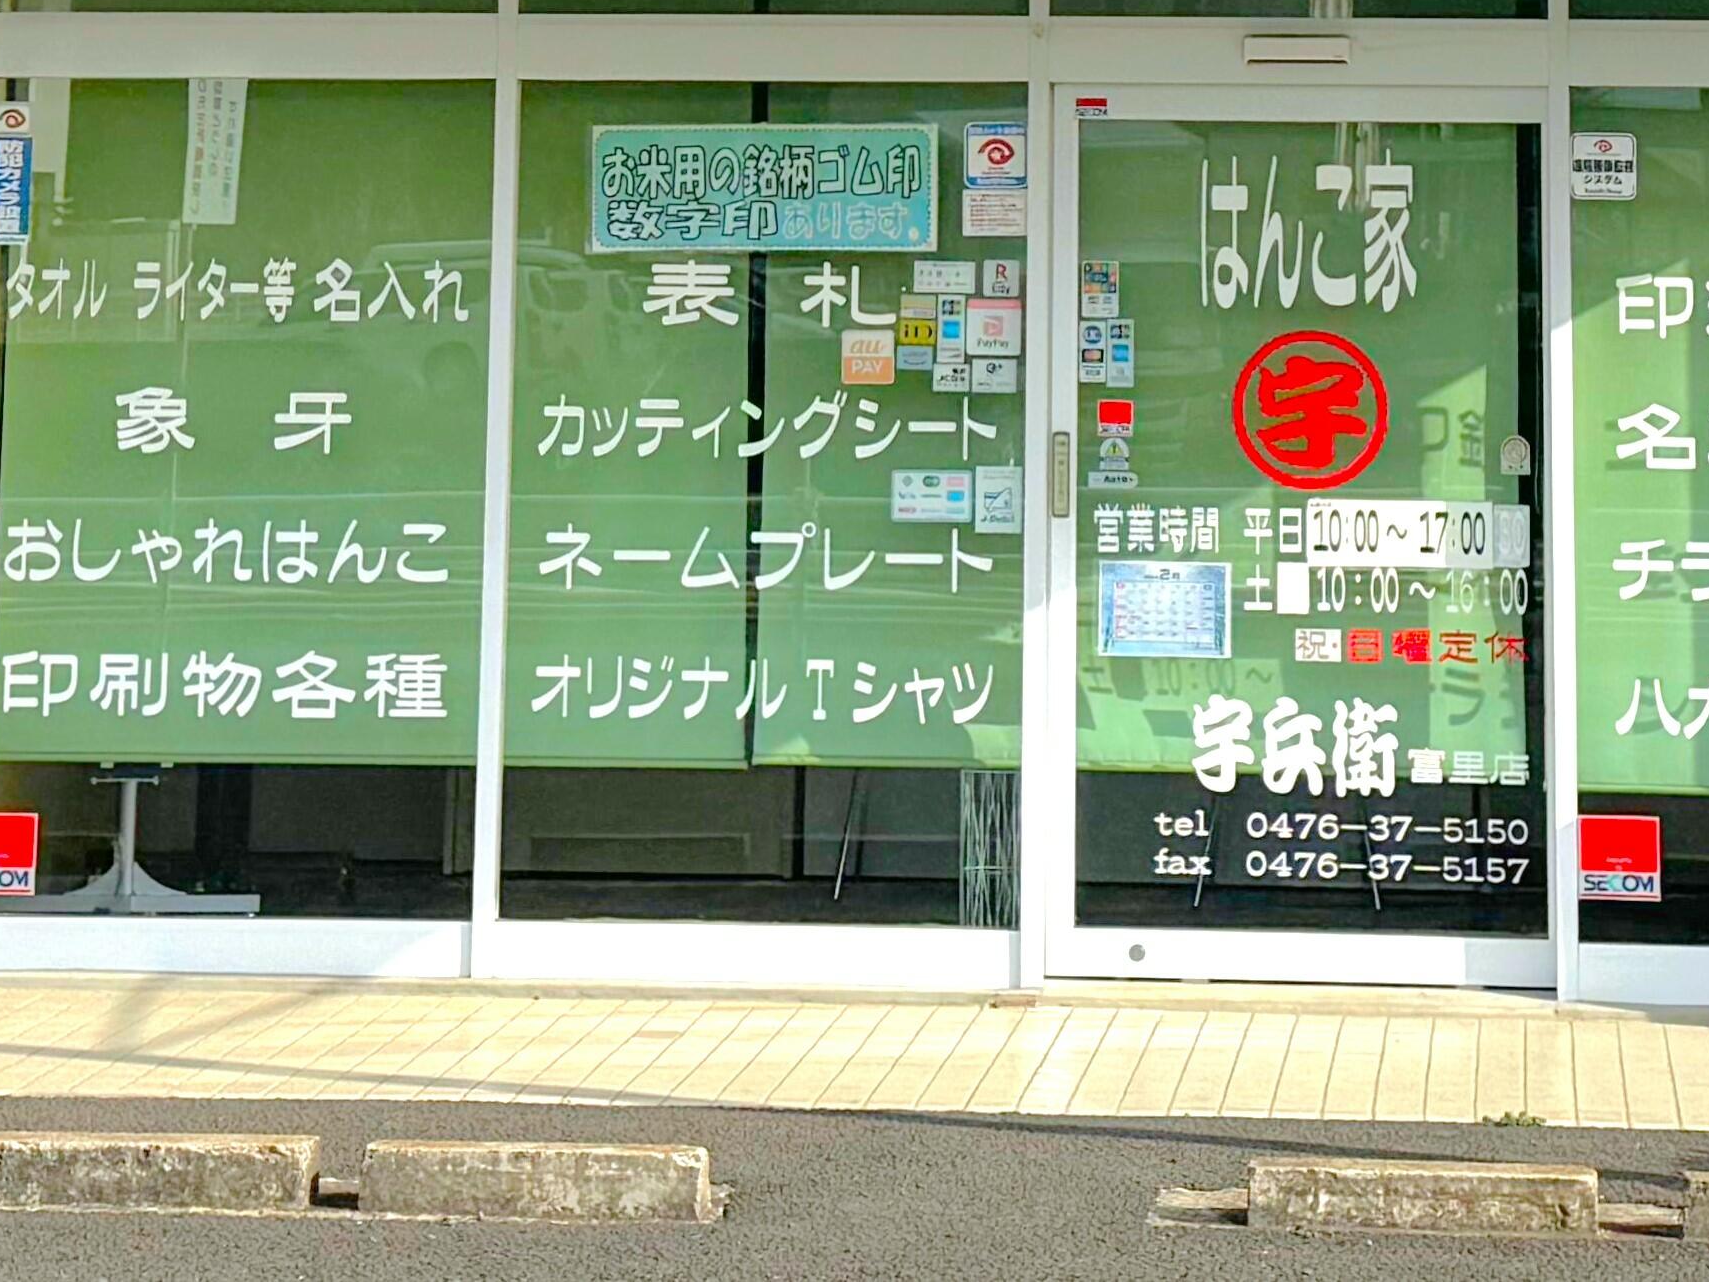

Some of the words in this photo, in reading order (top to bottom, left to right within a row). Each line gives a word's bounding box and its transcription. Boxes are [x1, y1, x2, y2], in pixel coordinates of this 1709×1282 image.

[601, 143, 921, 201] お米用の銘柄ゴム印
[1201, 148, 1418, 313] はんこ家
[7, 257, 107, 321] タオル
[133, 256, 297, 323] ライター等
[314, 257, 470, 323] 名入れ
[642, 259, 897, 328] 表札
[851, 358, 884, 374] PAY
[115, 386, 353, 455] 象牙
[538, 390, 998, 461] カッティングシート
[2, 517, 450, 584] おしゃれはんこ
[538, 521, 993, 594] ネームプレート
[1093, 502, 1220, 555] 営業時間
[1244, 507, 1303, 555] 平日
[1243, 563, 1273, 612] 土
[1, 649, 449, 718] 印刷物各種
[531, 653, 994, 725] オリジナルTシャツ
[1192, 693, 1399, 798] 宇兵衛
[1407, 748, 1530, 787] 富里店
[1153, 809, 1211, 838] tel
[1246, 811, 1530, 846] 0476-37-5150
[1153, 847, 1212, 877] fax
[1246, 850, 1531, 885] 0476-37-5157
